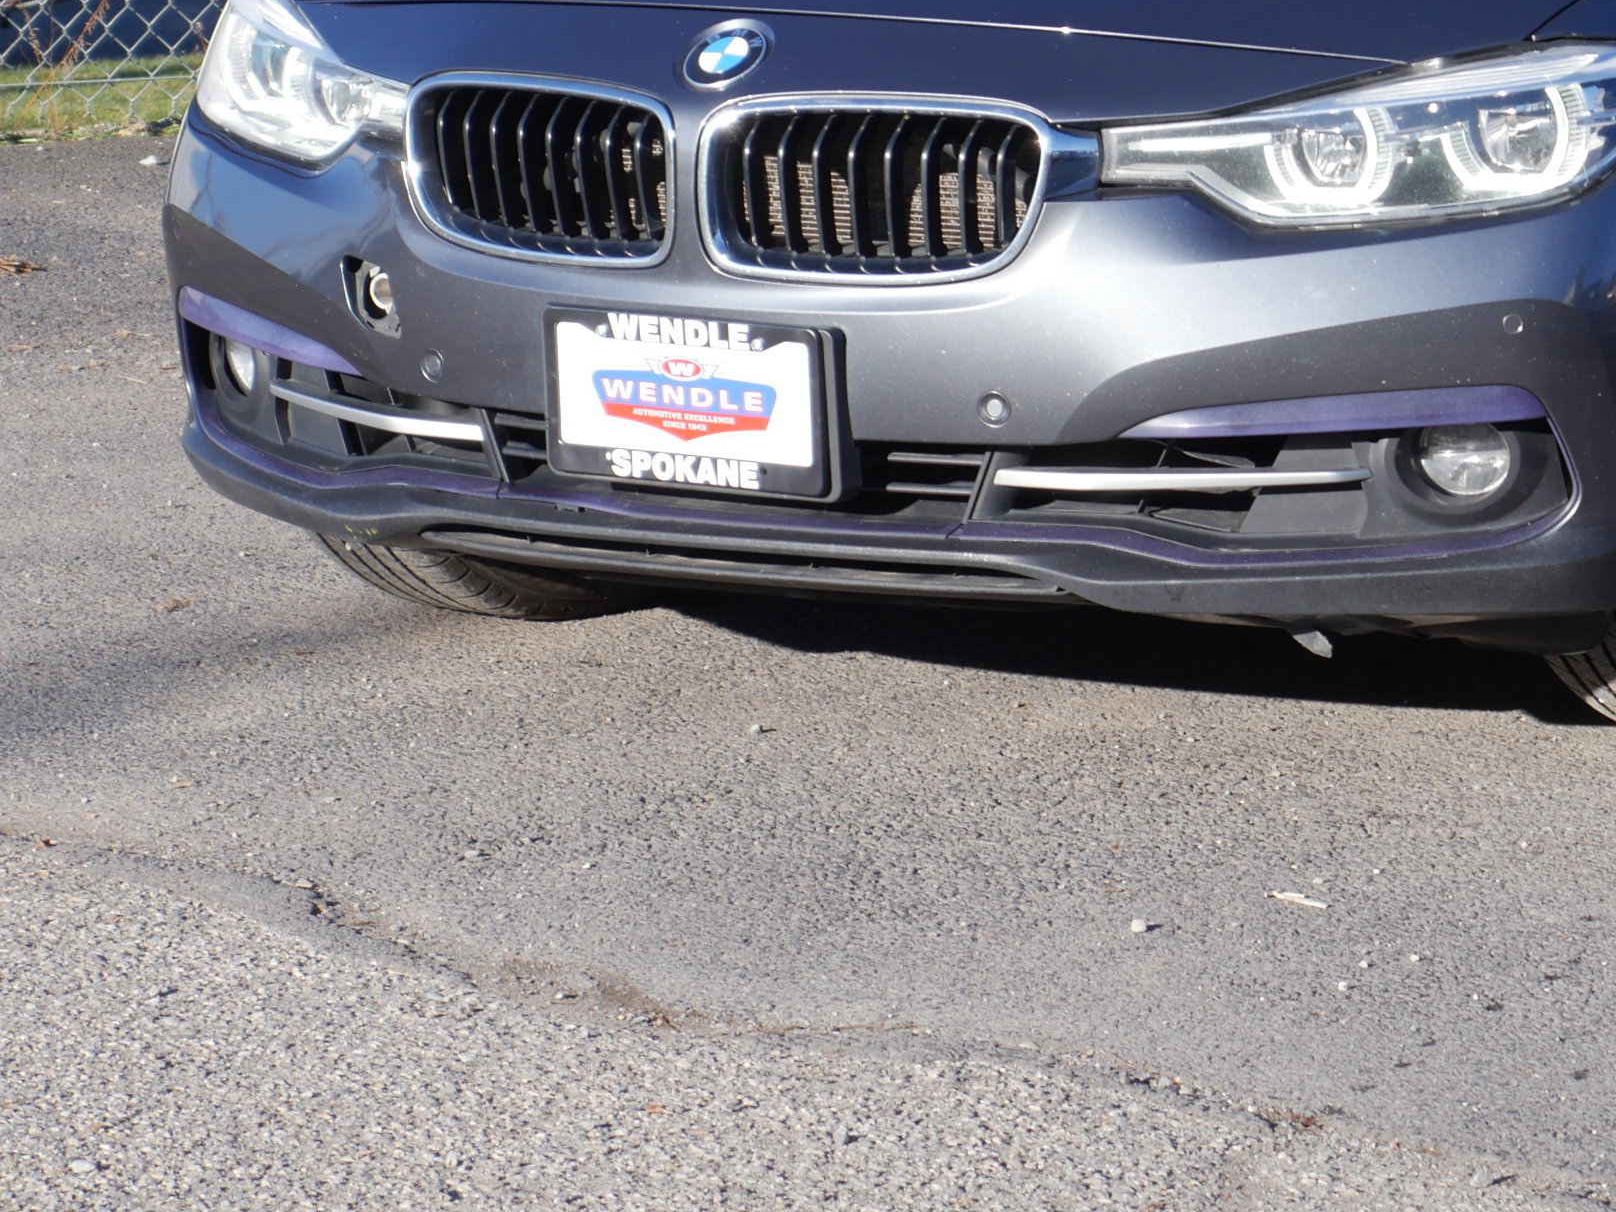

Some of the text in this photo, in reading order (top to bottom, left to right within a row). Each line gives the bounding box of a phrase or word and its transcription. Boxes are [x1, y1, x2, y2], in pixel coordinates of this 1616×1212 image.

[607, 312, 751, 351] WENDLE
[601, 377, 763, 413] WENDLE
[632, 407, 735, 425] AUTOMOTIVE EXCELLENCE
[662, 420, 686, 430] SINCE
[611, 448, 760, 490] SPOKANE
